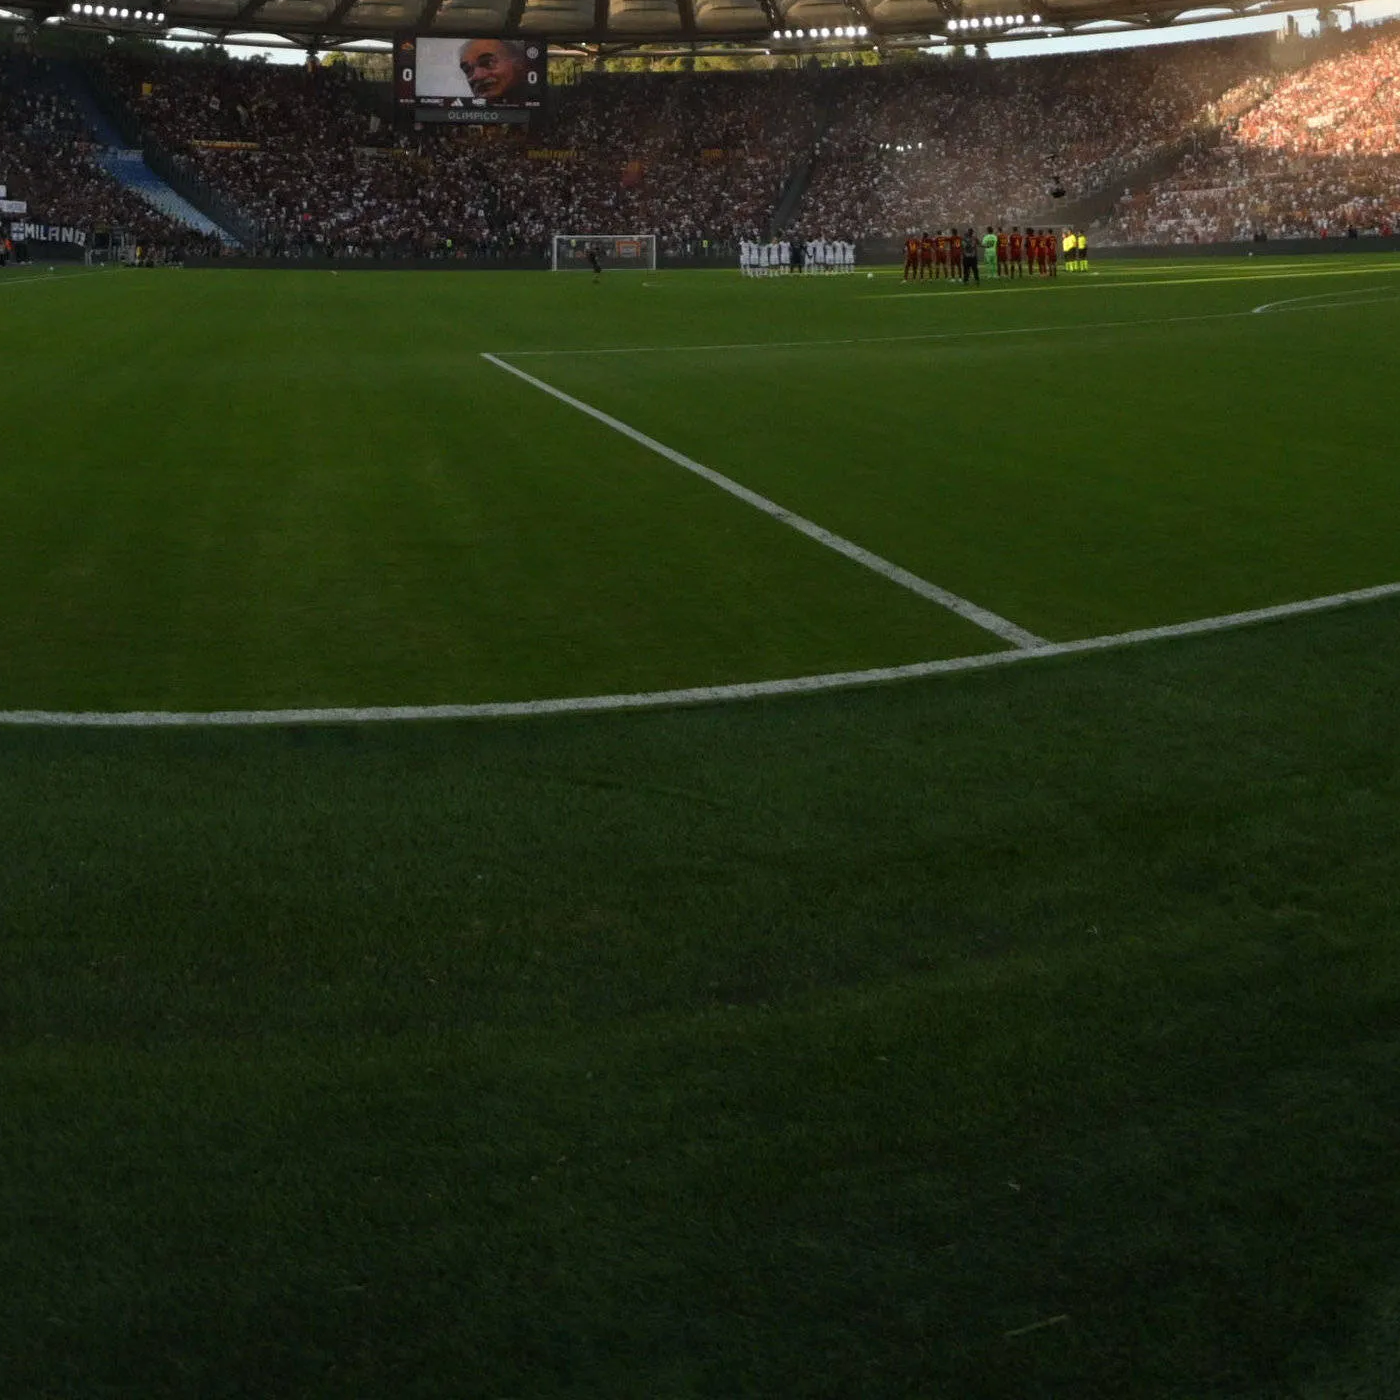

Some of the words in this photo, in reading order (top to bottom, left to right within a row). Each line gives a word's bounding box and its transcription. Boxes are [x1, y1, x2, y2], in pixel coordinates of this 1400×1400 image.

[402, 68, 412, 81] 0
[527, 71, 538, 84] 0
[448, 111, 499, 122] OLIMPICO
[24, 223, 86, 247] MILANO
